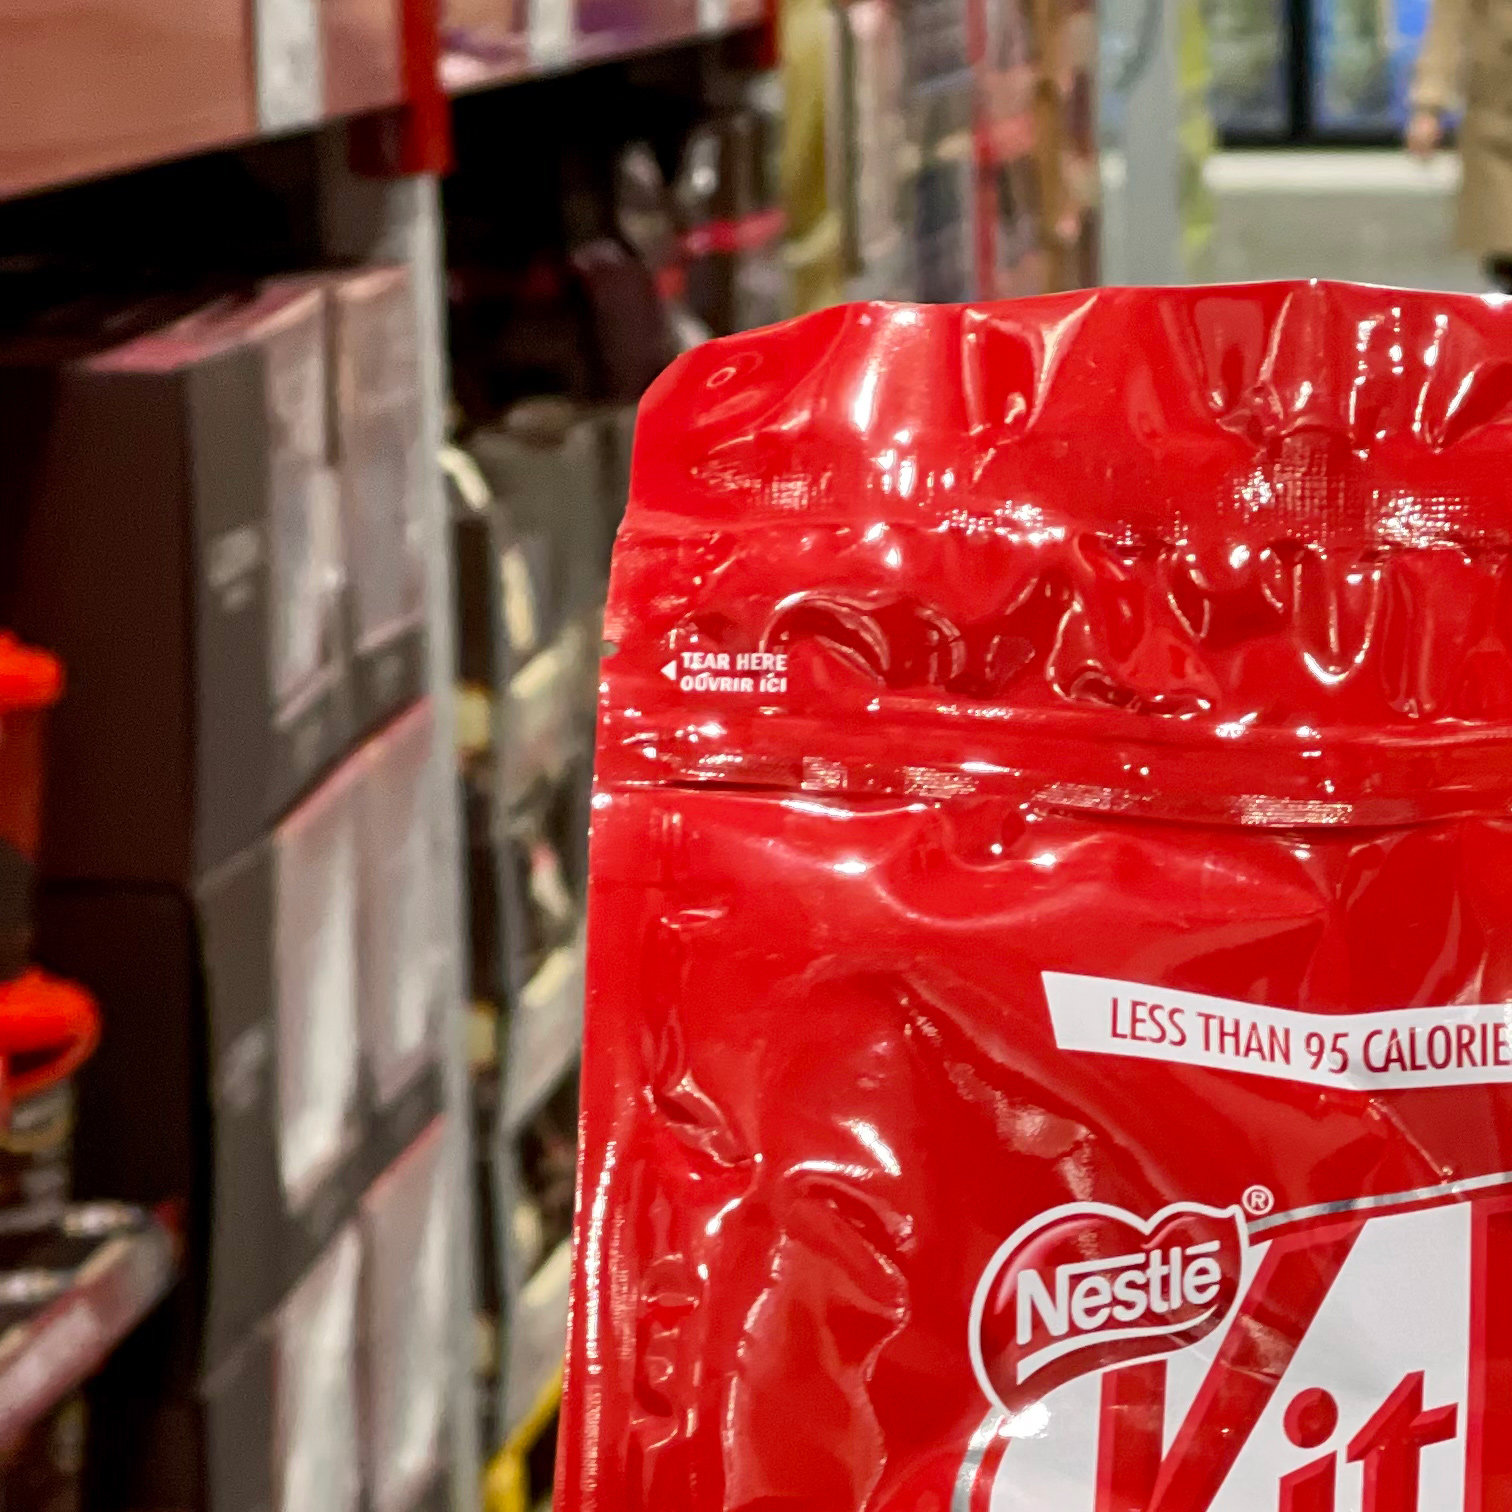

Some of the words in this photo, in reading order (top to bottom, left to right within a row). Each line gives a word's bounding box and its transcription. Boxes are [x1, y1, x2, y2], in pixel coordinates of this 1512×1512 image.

[681, 652, 731, 671] TEAR
[736, 652, 788, 671] HERE
[680, 675, 754, 692] OUVRIR
[760, 676, 788, 693] ICI
[1110, 996, 1188, 1047] LESS
[1196, 1010, 1291, 1066] THAN
[1304, 1030, 1350, 1075] 95
